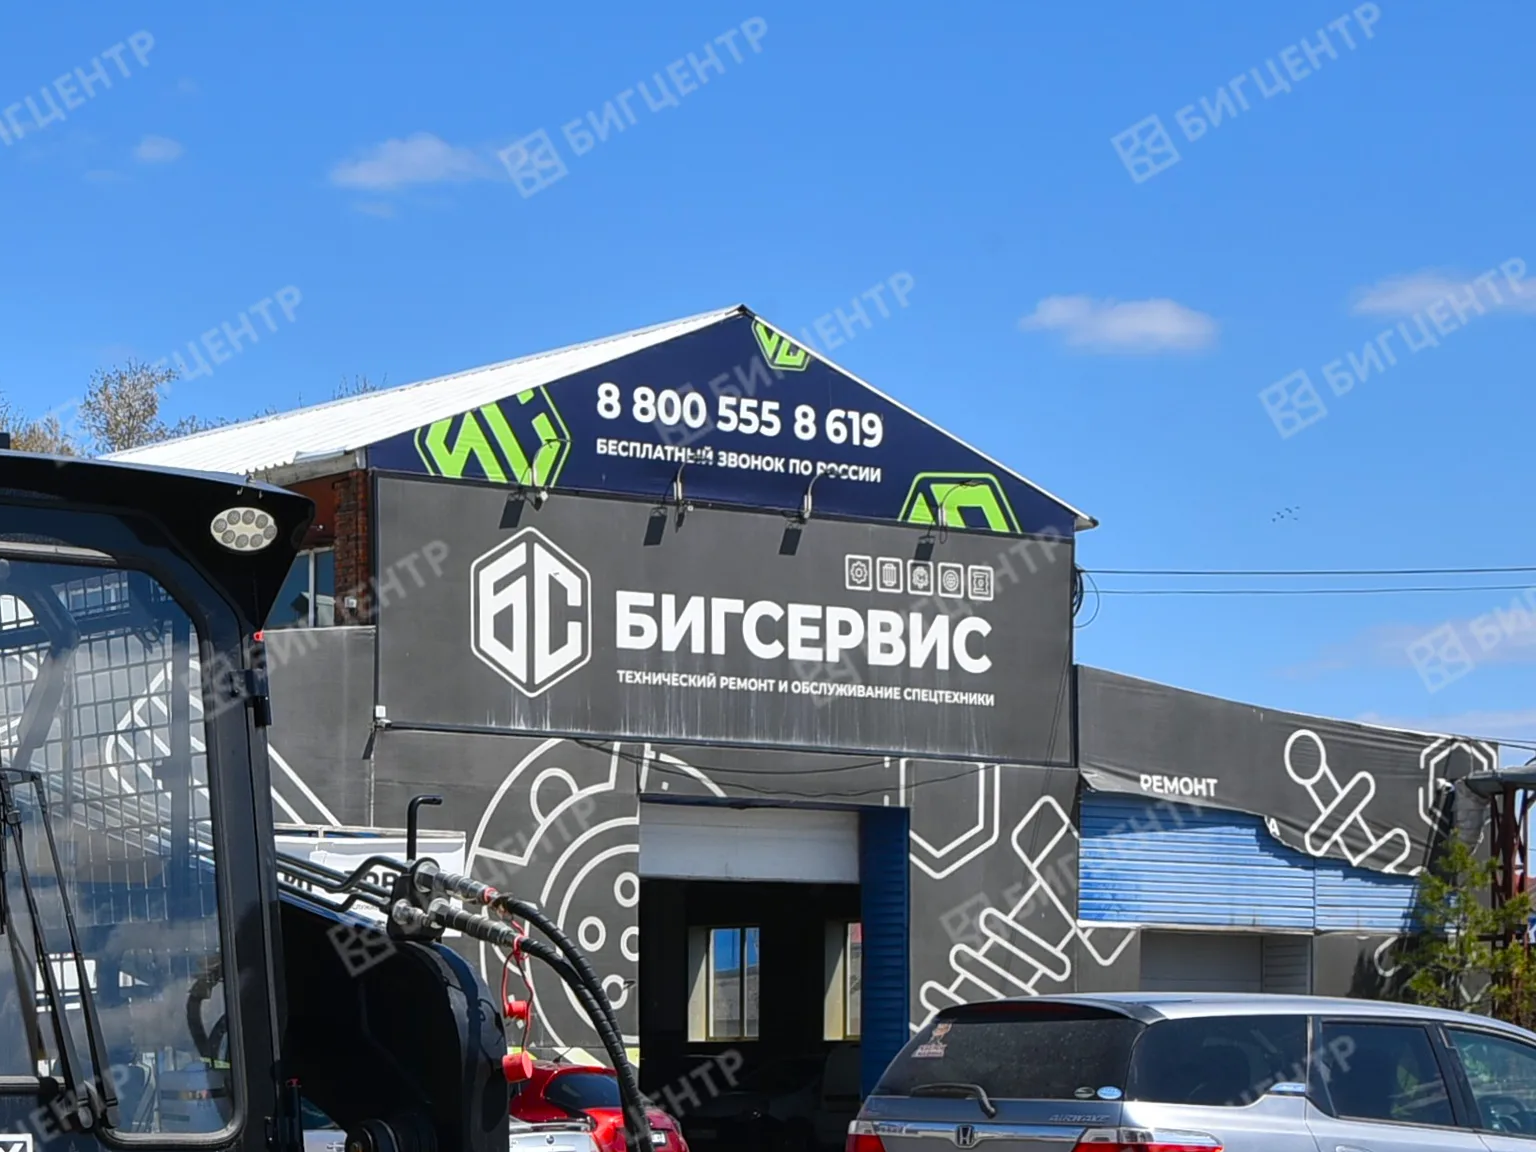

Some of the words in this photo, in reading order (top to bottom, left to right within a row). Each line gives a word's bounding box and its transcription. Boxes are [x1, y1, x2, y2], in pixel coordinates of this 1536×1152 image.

[597, 382, 621, 419] 8
[632, 386, 707, 428] 800
[716, 395, 781, 437] 555
[793, 404, 816, 441] 8
[825, 408, 884, 448] 619
[596, 438, 714, 466] БЕСПЛАТНЫЙ
[717, 450, 784, 473] ЗВОНОК
[789, 458, 813, 475] ПО
[615, 590, 994, 675] БИГСЕРВИС
[616, 669, 717, 689] ТЕХНИЧЕСКИЙ
[720, 677, 776, 694] РЕМОНТ
[779, 681, 789, 694] И
[791, 680, 902, 701] ОБСЛУЖИВАНИЕ
[903, 690, 995, 707] СПЕЦТЕХНИКИ
[1140, 774, 1218, 797] РЕМОНТ
